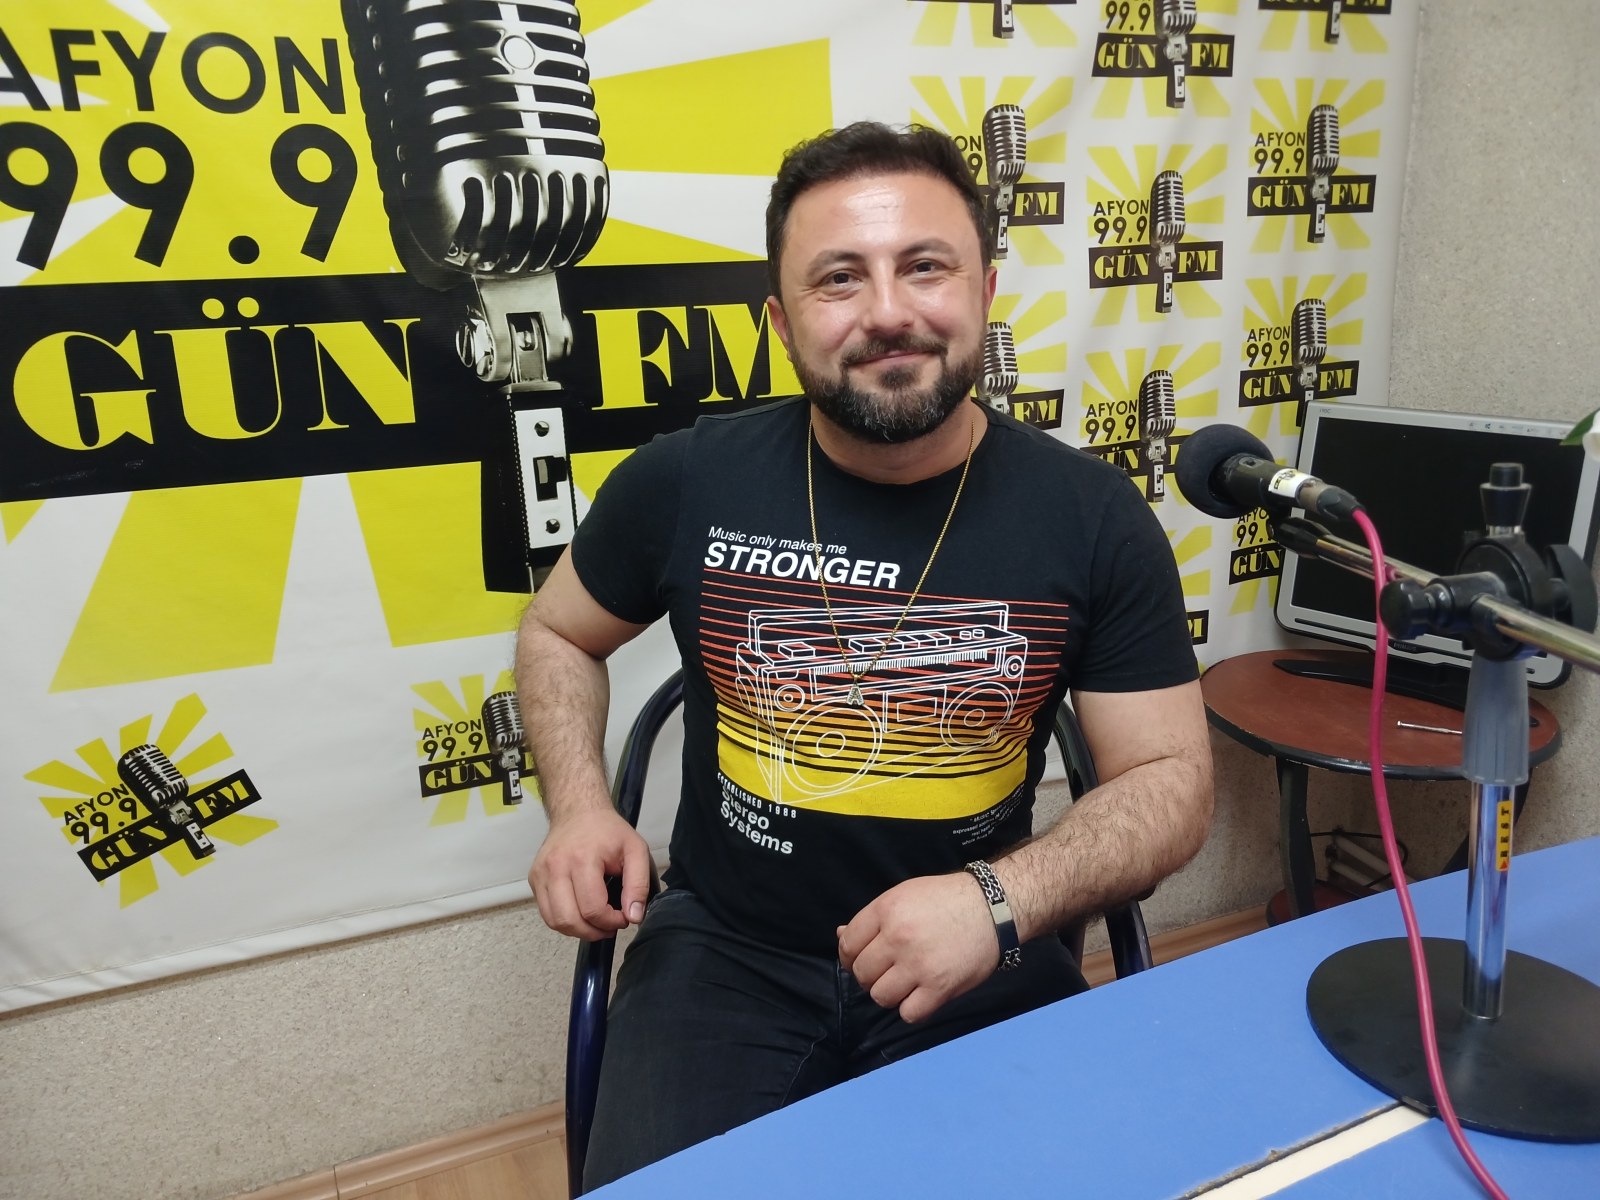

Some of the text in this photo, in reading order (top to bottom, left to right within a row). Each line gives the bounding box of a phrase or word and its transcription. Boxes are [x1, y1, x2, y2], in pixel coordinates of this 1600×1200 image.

[1105, 1, 1151, 31] 99.9
[1097, 37, 1230, 69] GÜN FM
[1255, 131, 1305, 147] AFYON
[1254, 148, 1304, 174] 99.9
[0, 121, 358, 271] 99.9
[1013, 191, 1060, 217] FM
[1093, 199, 1149, 216] AFYON
[1251, 180, 1371, 208] GÜN FM
[1094, 216, 1147, 244] 99.9
[1094, 249, 1219, 279] GÜN FM
[1246, 325, 1290, 342] AFYON
[1246, 341, 1290, 367] 99.9
[13, 296, 802, 451] GÜN FM
[1243, 368, 1355, 399] GÜN FM
[1012, 398, 1059, 423] FM
[1085, 399, 1138, 418] AFYON
[1085, 415, 1136, 444] 99.9
[1100, 446, 1141, 471] ÜN
[1237, 506, 1268, 524] AFYO
[708, 526, 847, 555] Music only makes me
[704, 541, 900, 589] STRONGER
[1233, 547, 1283, 576] GÜN
[422, 719, 482, 740] AFYON
[422, 732, 484, 761] 99.9
[425, 759, 492, 789] GÜN
[63, 783, 130, 826] AFYON
[722, 784, 770, 830] Stereo
[768, 803, 797, 818] 1988
[70, 797, 138, 845] 99.9
[91, 779, 250, 870] GÜN FM
[720, 800, 794, 854] Systems
